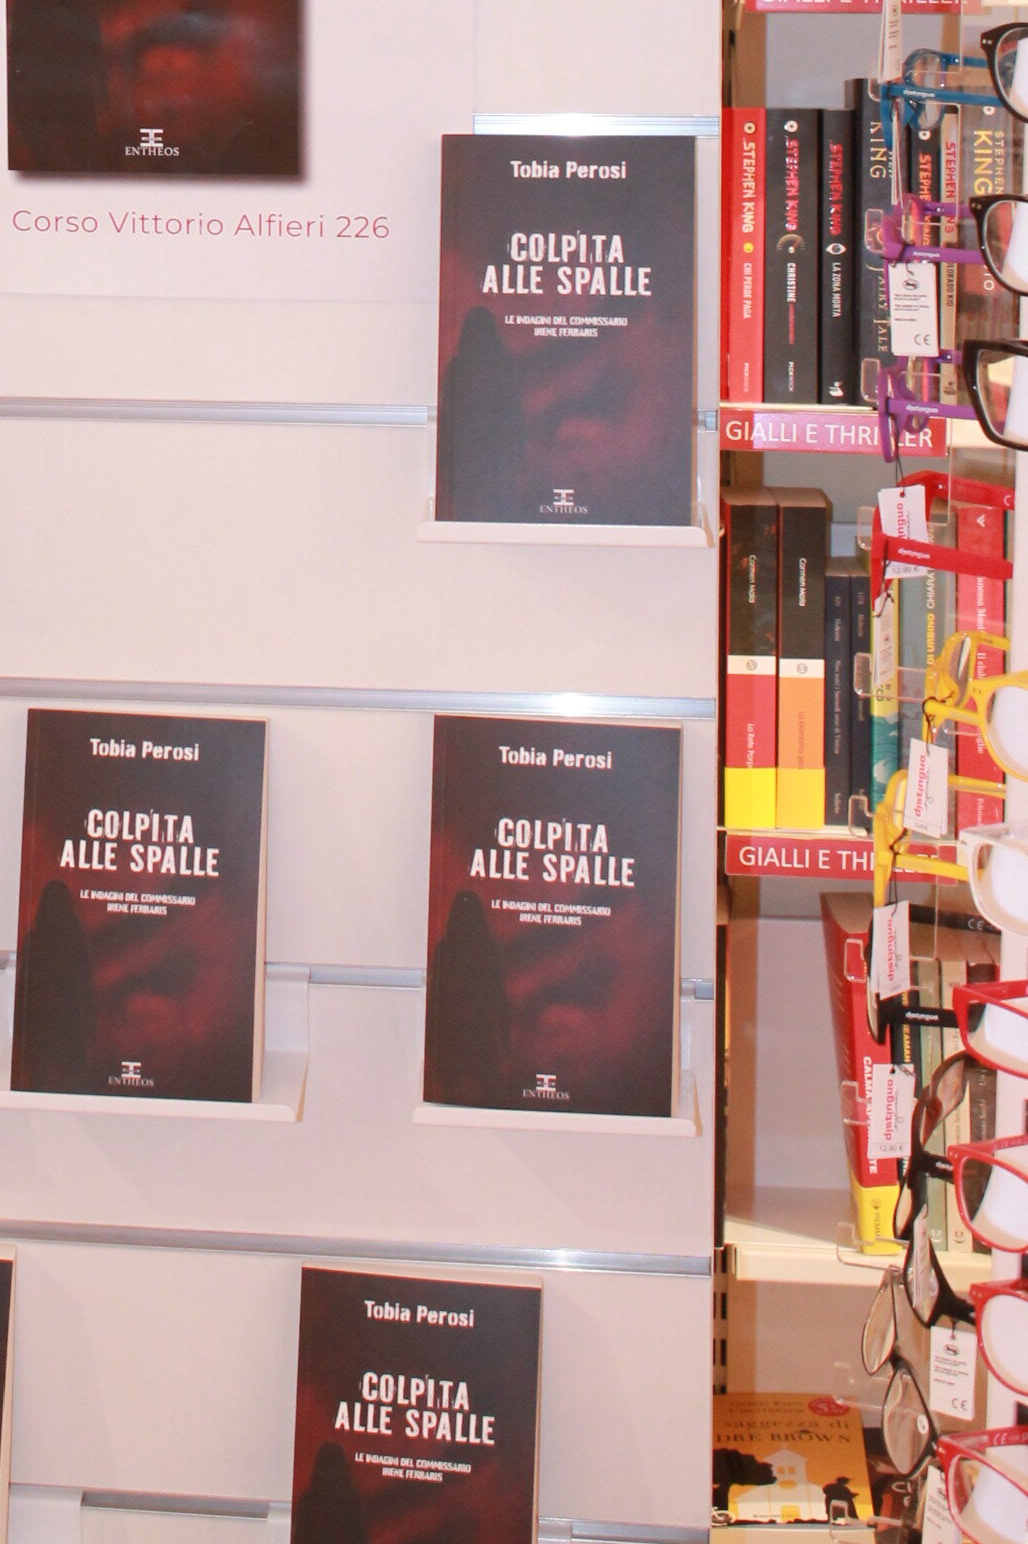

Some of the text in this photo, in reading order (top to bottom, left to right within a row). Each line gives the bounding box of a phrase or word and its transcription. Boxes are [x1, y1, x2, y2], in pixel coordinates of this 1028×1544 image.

[125, 146, 179, 156] ENTHEOS
[974, 131, 993, 195] KING
[510, 161, 626, 179] Tobia Perosi
[742, 139, 756, 232] STEPHEN KING
[785, 136, 799, 231] STEPHEN KING
[13, 210, 98, 232] Corso
[109, 212, 223, 235] Vittorio
[235, 214, 323, 237] Alfieri
[336, 216, 389, 238] 226
[508, 230, 623, 263] COLPITA
[483, 265, 651, 295] ALLE SPALLE
[743, 263, 752, 319] CHI PERDE PAGA
[726, 420, 934, 449] GIALLI E THRIER
[90, 738, 199, 761] Tobia Perosi
[499, 746, 611, 769] Tobia Perosi
[85, 809, 193, 843] COLPITA
[498, 818, 608, 853] COLPITA
[60, 840, 219, 876] ALLE SPALLE
[470, 849, 634, 886] ALLE SPALLE
[740, 846, 830, 869] GIALLI E
[884, 1078, 894, 1141] distinguo
[364, 1300, 474, 1327] Tobia Perosi
[362, 1372, 469, 1410] COLPITA
[335, 1401, 494, 1445] ALLE SPALLE
